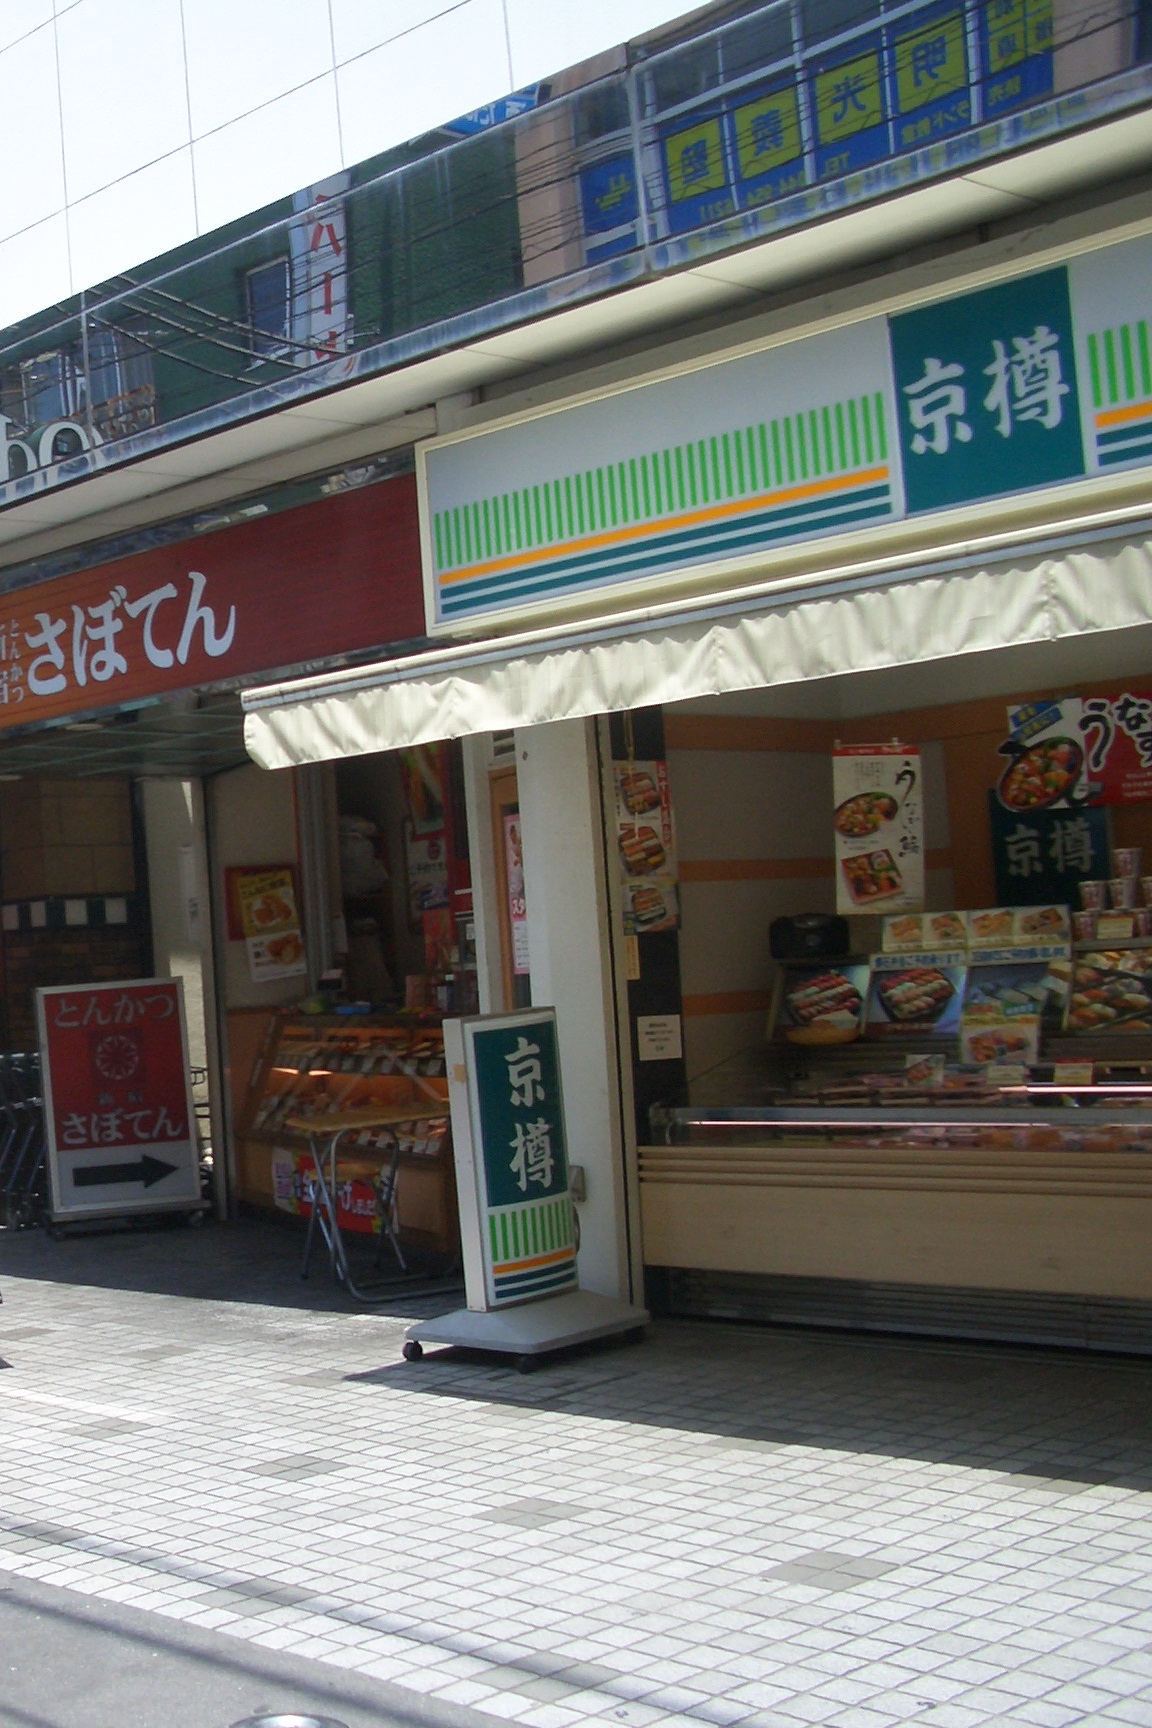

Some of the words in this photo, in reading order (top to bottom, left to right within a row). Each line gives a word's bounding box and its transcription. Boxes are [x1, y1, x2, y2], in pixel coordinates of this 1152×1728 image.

[902, 325, 1071, 456] 京樽
[8, 621, 25, 704] とんかつ
[25, 571, 236, 696] さぼてん
[1005, 816, 1096, 878] 京樽
[54, 993, 175, 1029] とんかつ
[60, 1106, 184, 1145] さぼてん
[504, 1035, 555, 1192] 京樽
